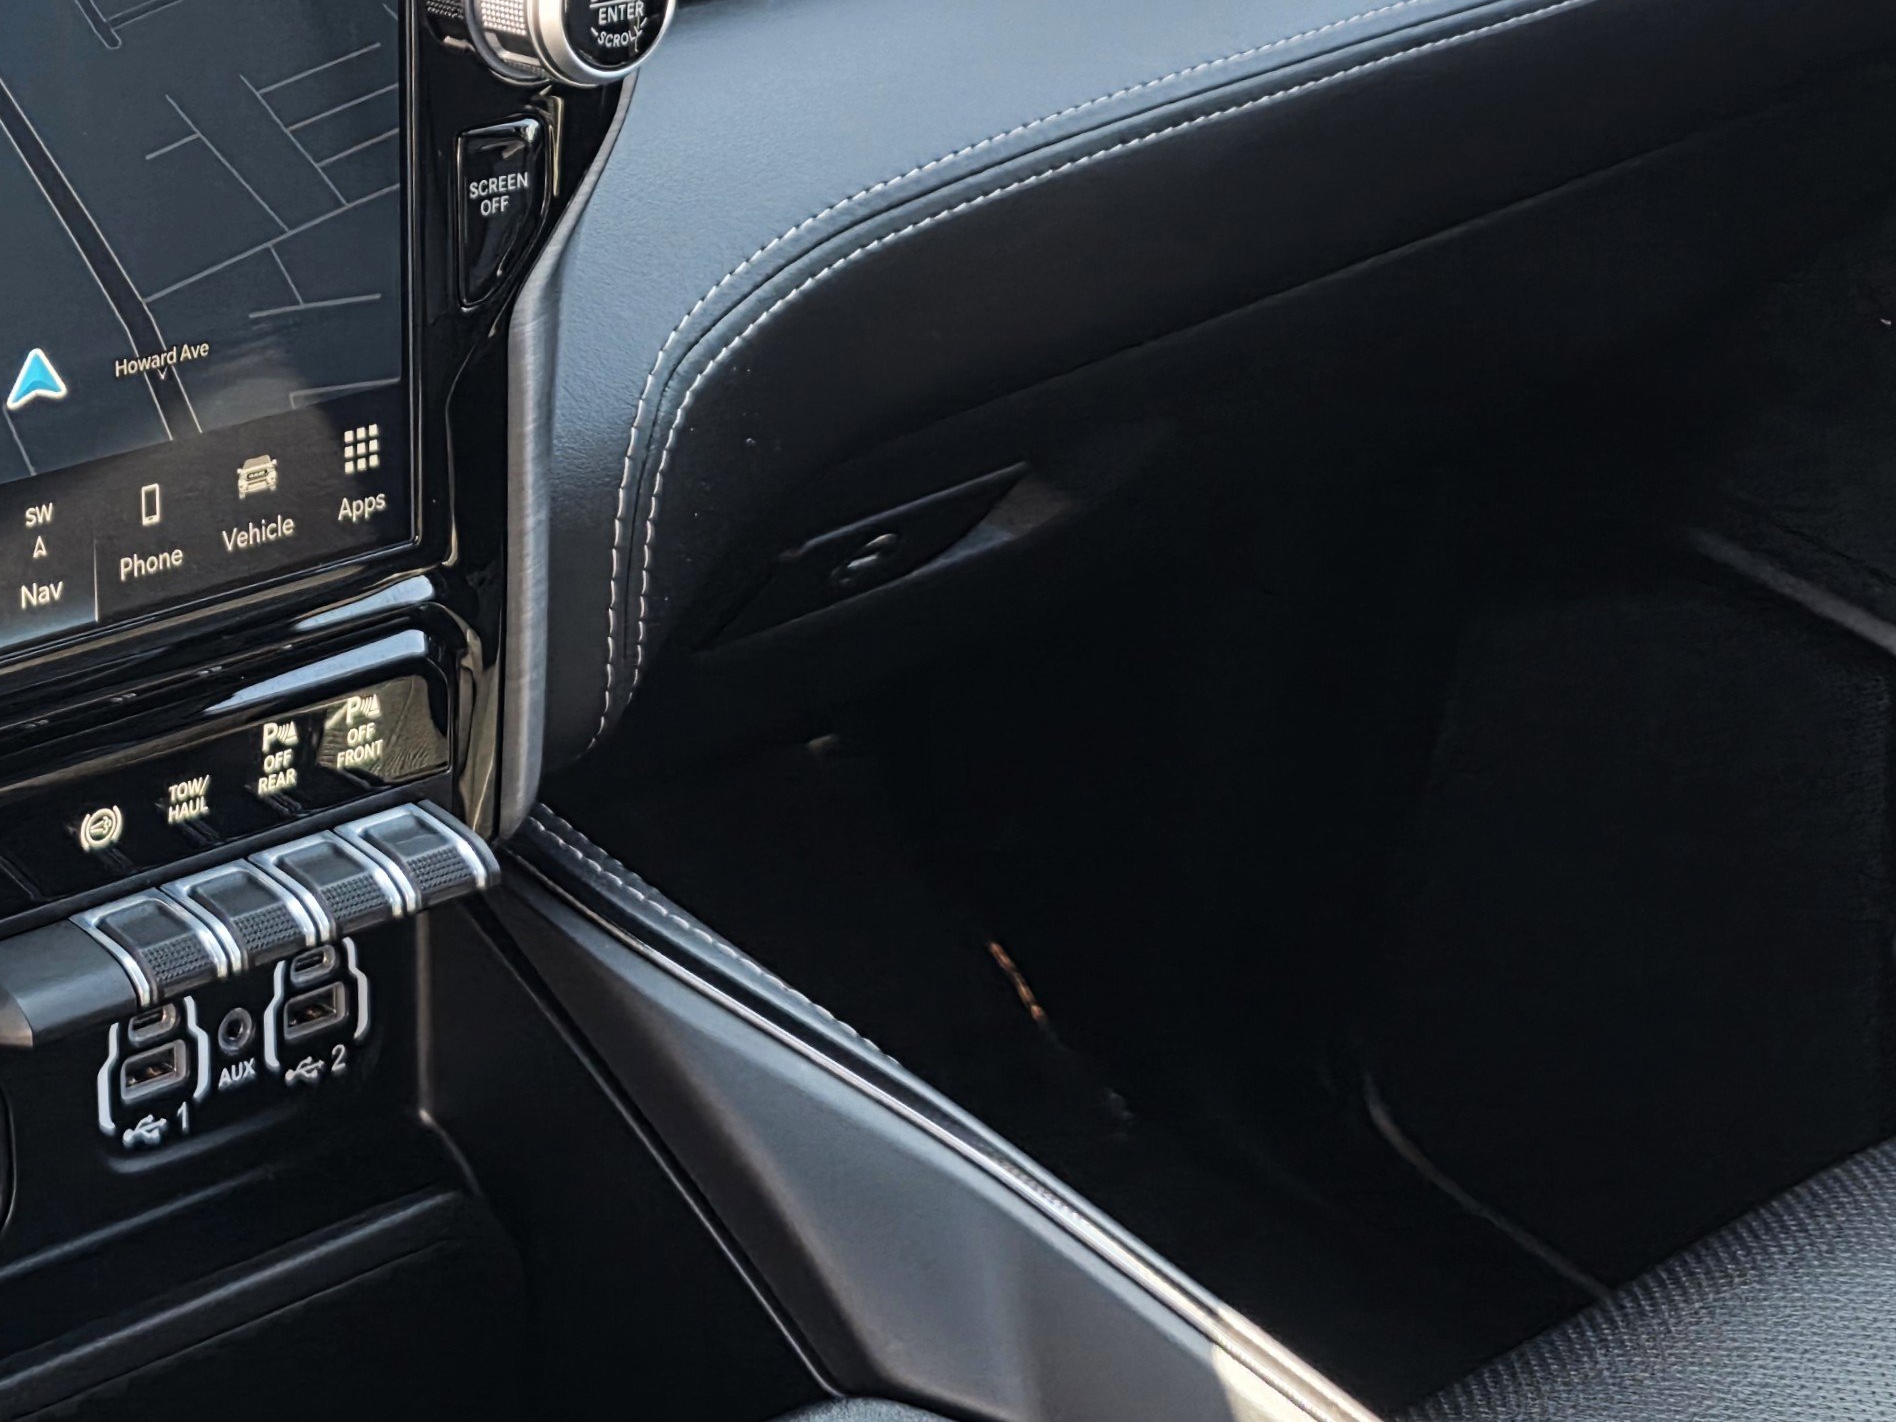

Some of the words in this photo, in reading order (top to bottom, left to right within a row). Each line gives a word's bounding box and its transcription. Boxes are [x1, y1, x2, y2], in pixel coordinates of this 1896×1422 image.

[598, 2, 644, 25] ENTER
[597, 26, 643, 49] SCROLL
[469, 172, 529, 200] SCREEN
[480, 197, 510, 217] OFF
[115, 346, 177, 377] Howard
[180, 343, 209, 361] Ave
[25, 502, 54, 527] SW
[338, 492, 386, 524] Apps
[222, 514, 295, 553] Vehicle
[120, 547, 184, 581] Phone
[20, 581, 63, 610] Nav
[347, 721, 376, 747] OFF
[263, 748, 294, 774] OFF
[336, 740, 384, 769] FRONT
[168, 775, 210, 801] TOW/
[258, 768, 297, 796] REAR
[168, 795, 209, 824] HAUL
[330, 1044, 346, 1073] 2
[218, 1058, 255, 1089] AUX
[177, 1101, 189, 1133] 1
